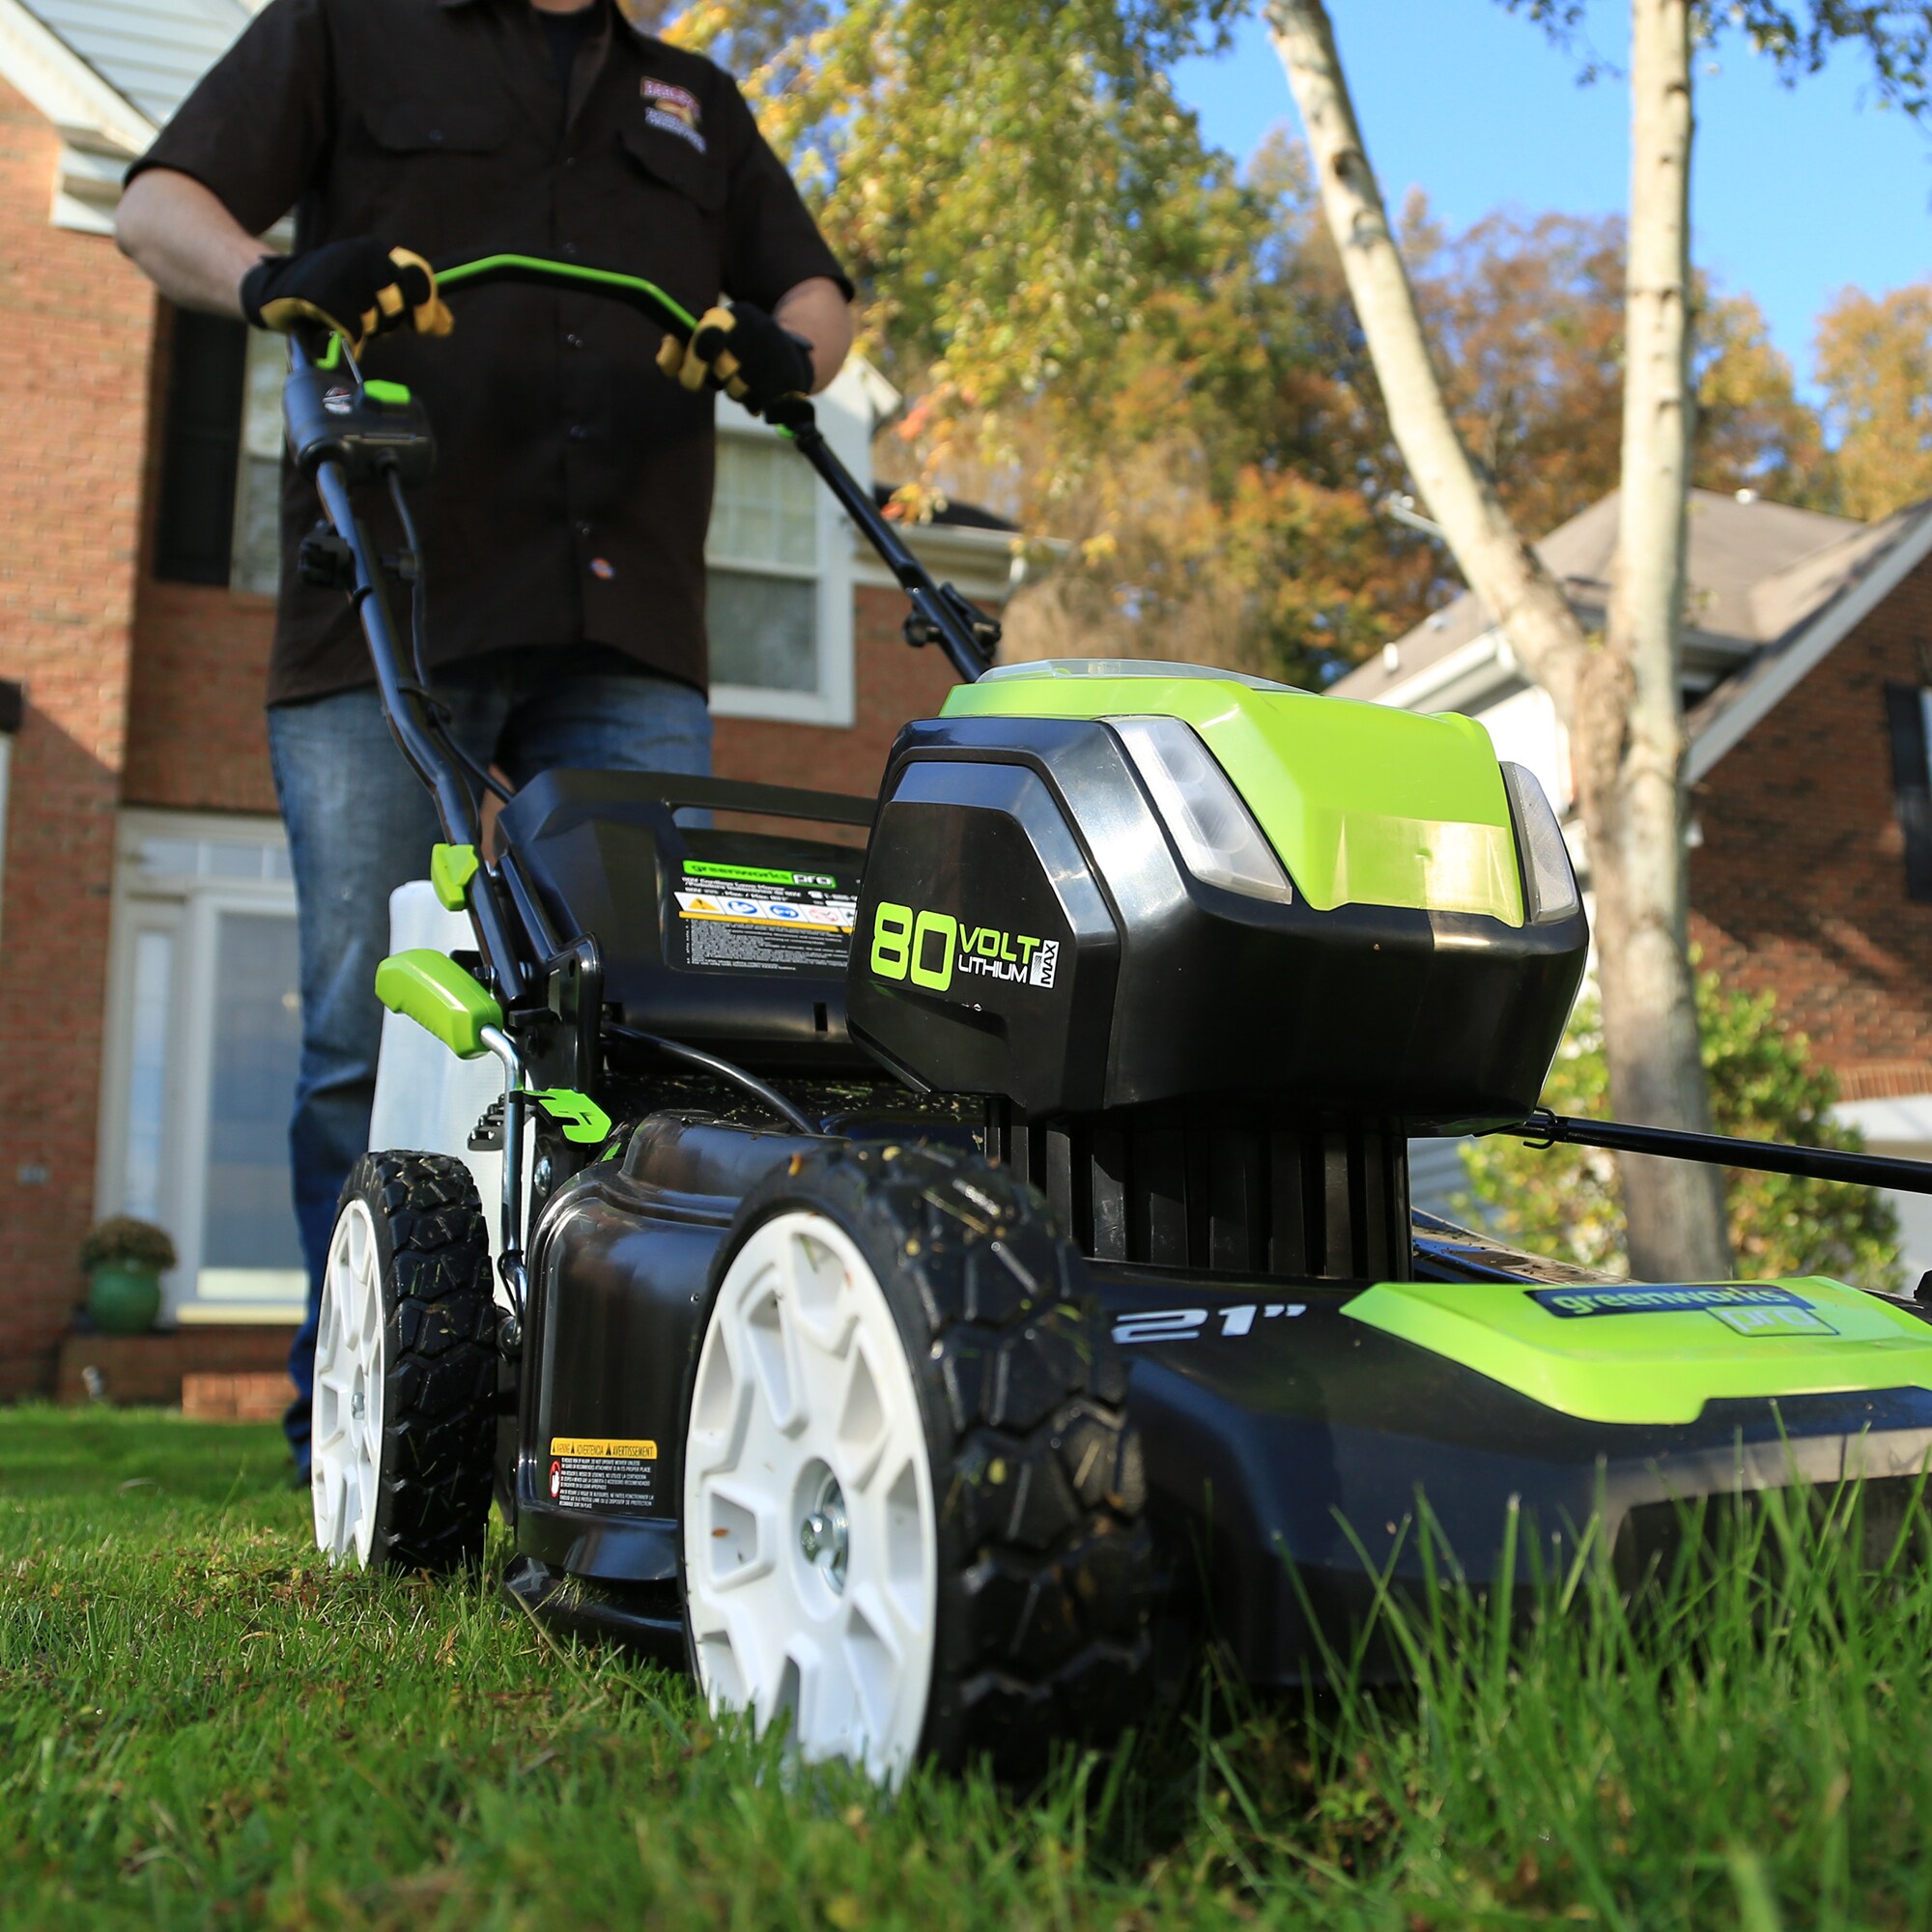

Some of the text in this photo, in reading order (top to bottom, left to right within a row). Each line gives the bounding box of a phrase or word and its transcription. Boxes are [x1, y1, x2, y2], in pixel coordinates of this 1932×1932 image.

[691, 864, 832, 886] greenworks pro
[870, 901, 957, 992] 80
[959, 923, 1040, 965] VOLT
[957, 953, 1028, 983] LITHIUM
[1040, 943, 1057, 984] MAX
[1551, 1288, 1791, 1314] greenworks
[1725, 1308, 1819, 1332] pro
[612, 1445, 654, 1458] AVERTISSEMENT
